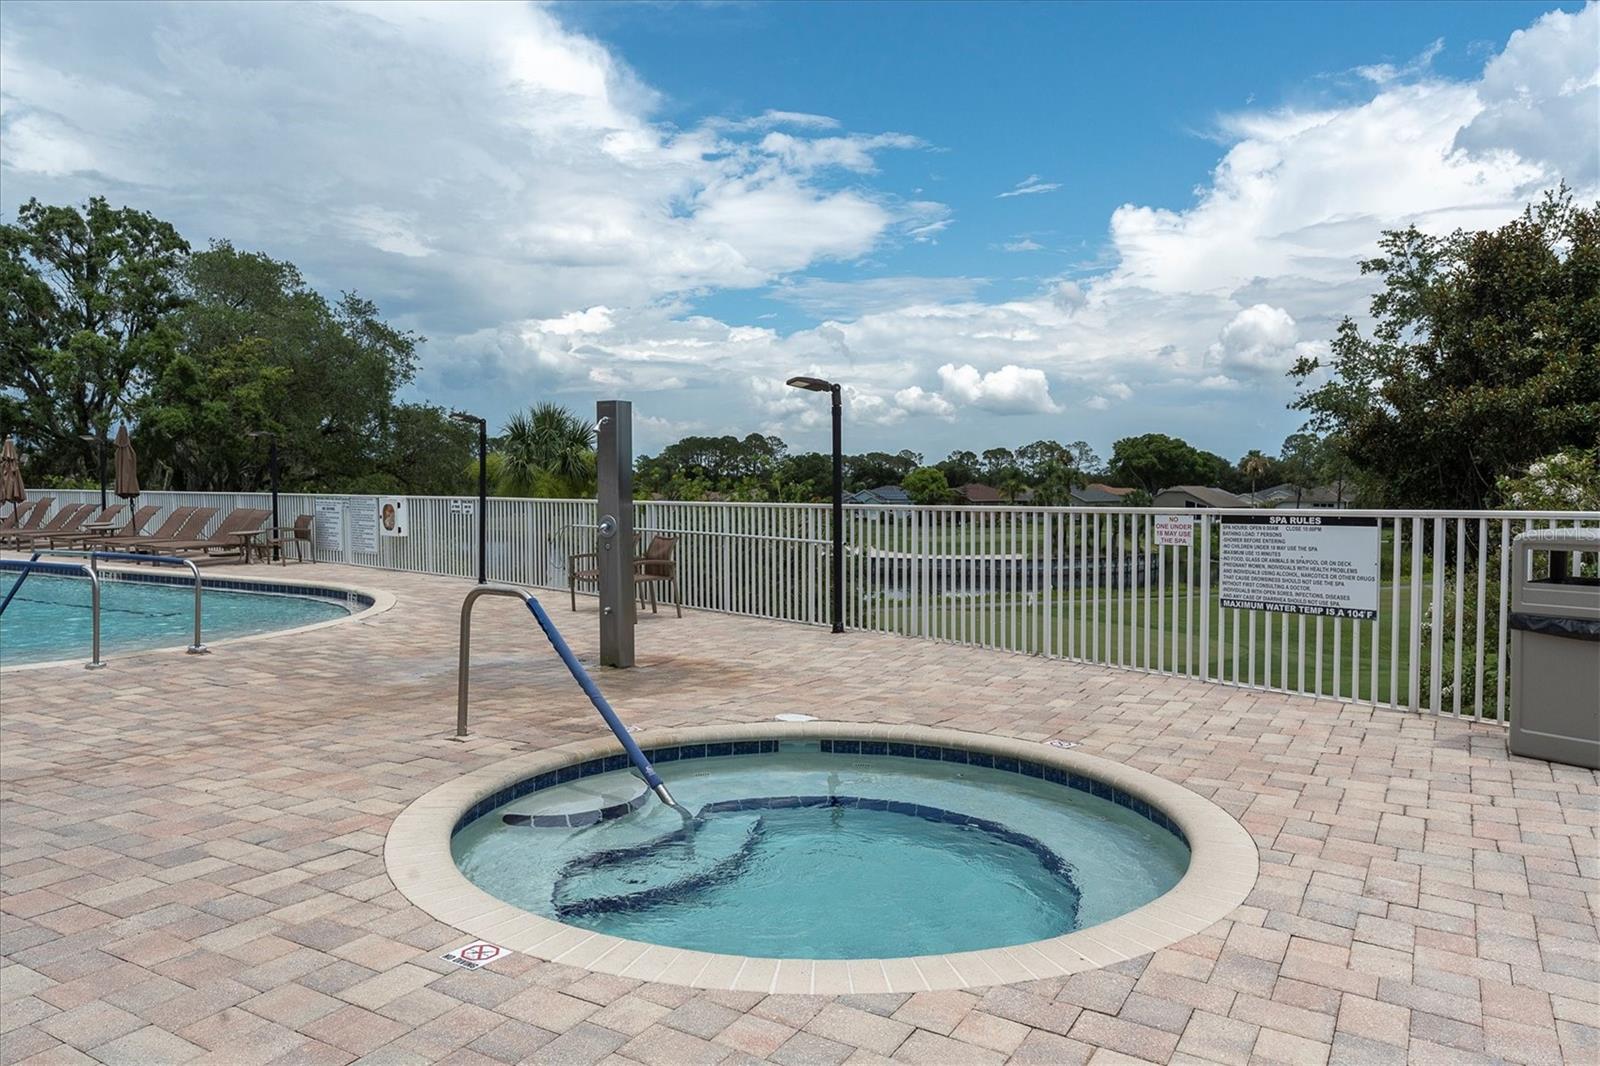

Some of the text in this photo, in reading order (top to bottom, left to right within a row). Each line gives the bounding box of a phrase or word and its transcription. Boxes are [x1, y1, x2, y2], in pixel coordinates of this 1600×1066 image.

[1224, 600, 1264, 609] MAXIMUM
[1266, 603, 1296, 612] WATER
[1299, 606, 1324, 614] TEMP
